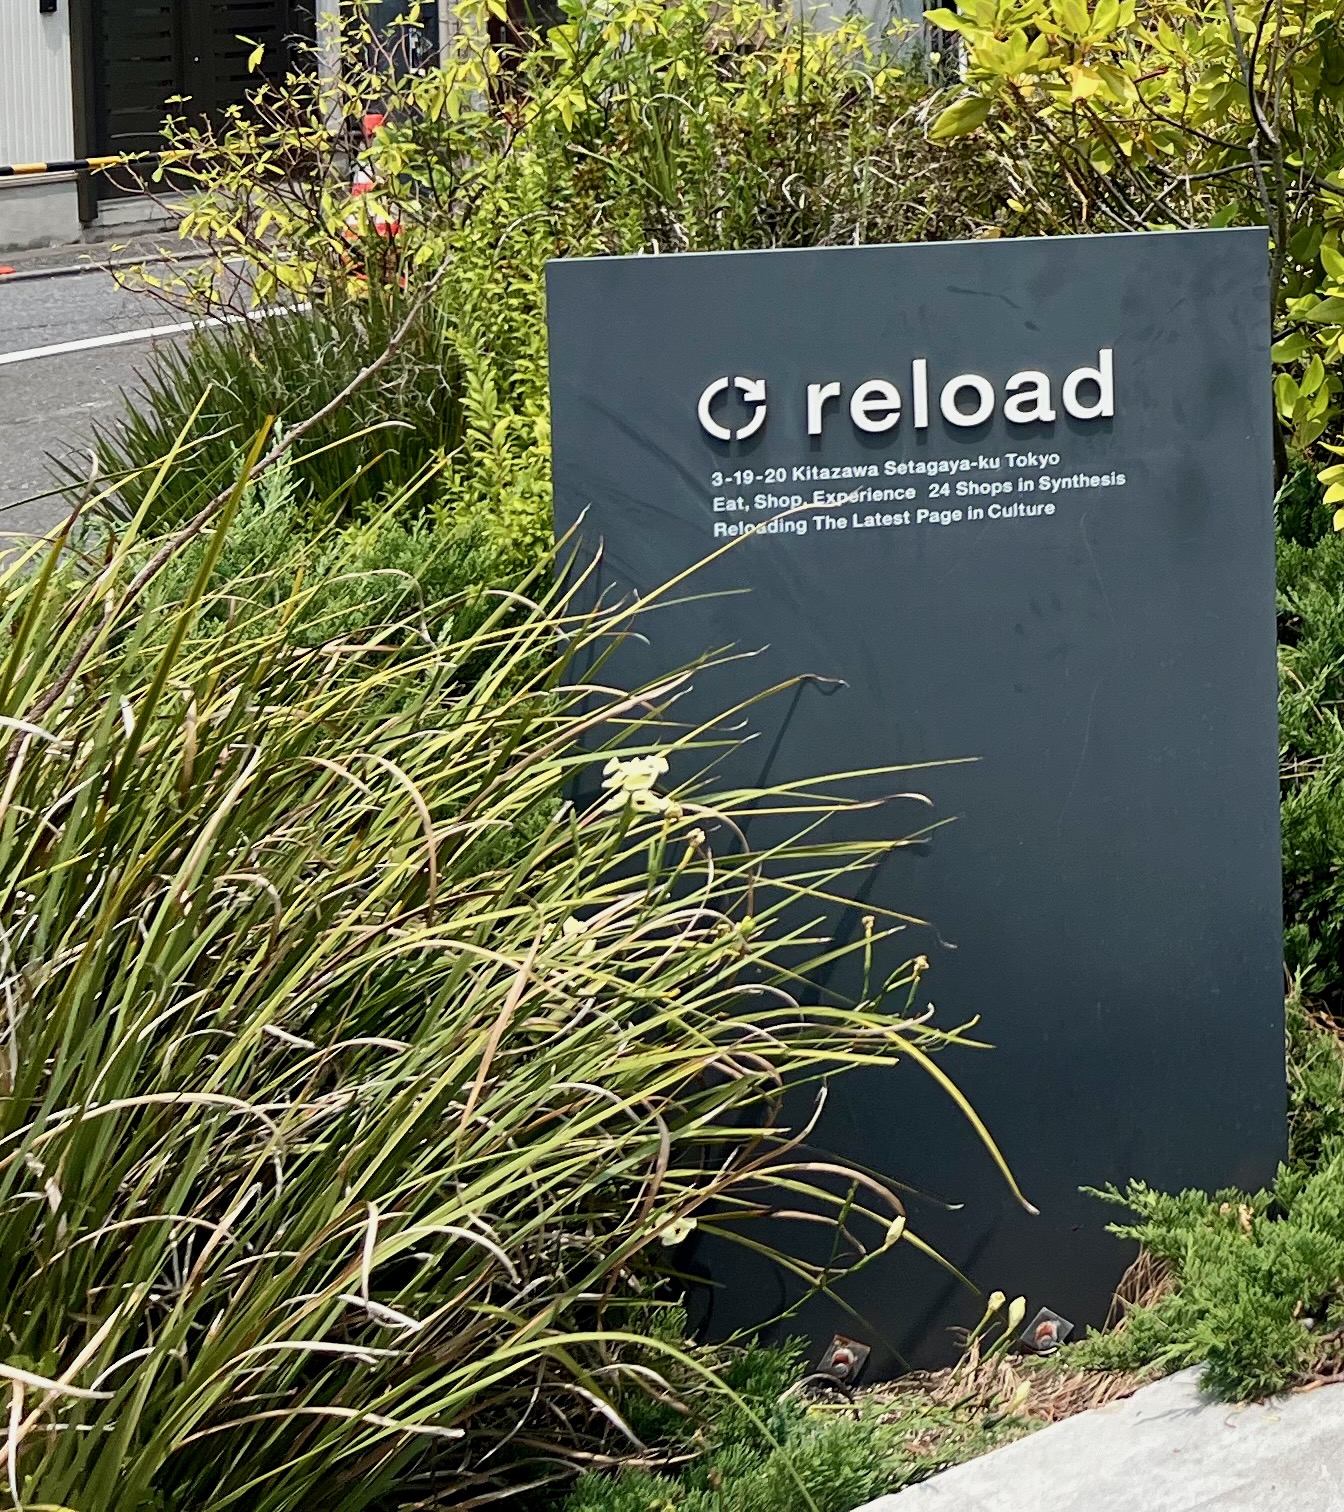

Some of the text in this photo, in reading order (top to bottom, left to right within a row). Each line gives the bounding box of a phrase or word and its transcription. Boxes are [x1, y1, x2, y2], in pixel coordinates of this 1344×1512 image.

[807, 348, 1114, 435] reload
[711, 451, 1061, 487] 3-19-20 Kitazawa Setagaya-ku Tokyo
[712, 495, 750, 513] Eat,
[812, 486, 916, 507] Experience
[928, 482, 951, 499] 24
[955, 479, 1013, 497] Shops
[1017, 476, 1035, 492] in
[1038, 470, 1127, 494] Synthesis
[713, 501, 1057, 538] Reloading The Latest Page in Culture
